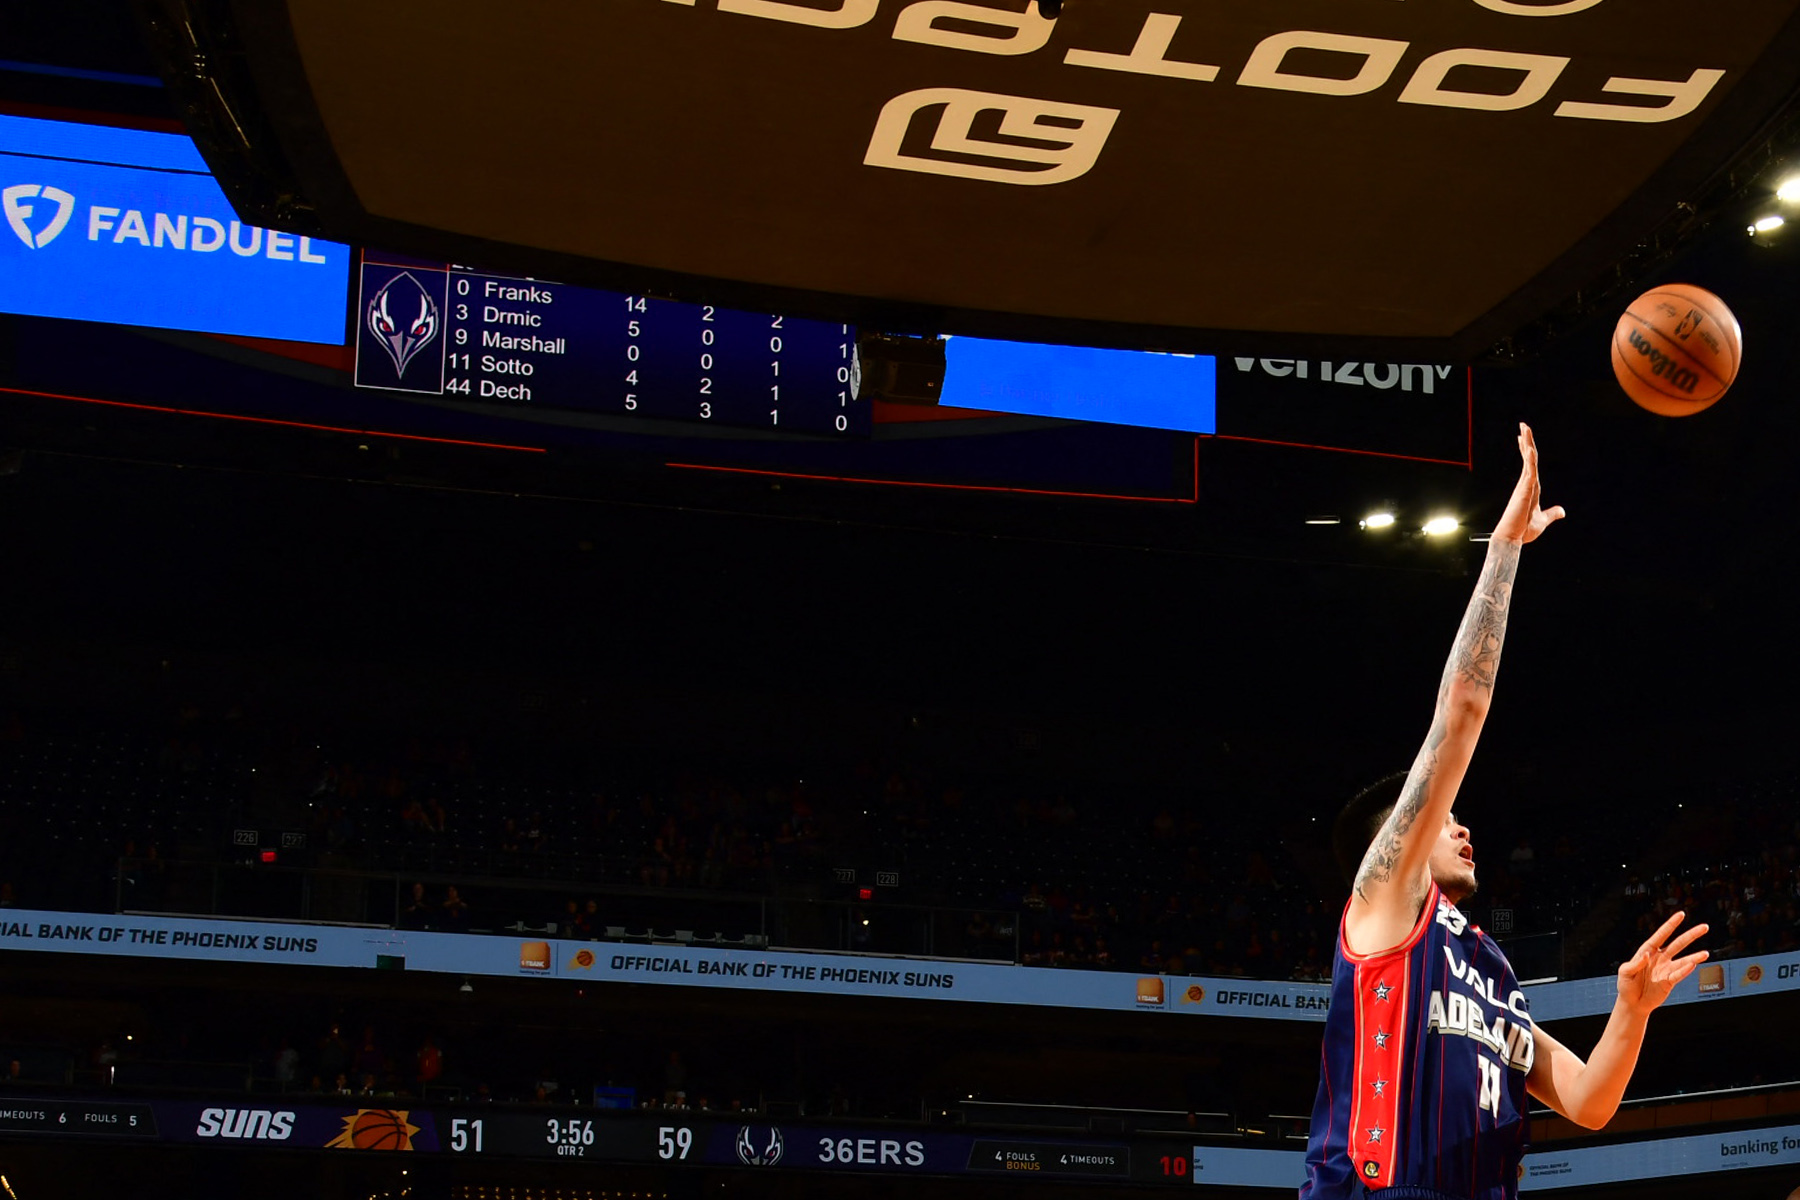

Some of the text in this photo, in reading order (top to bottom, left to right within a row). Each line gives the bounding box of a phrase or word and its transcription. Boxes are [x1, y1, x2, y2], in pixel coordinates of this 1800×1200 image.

[88, 205, 326, 264] FANDUEL
[457, 280, 715, 321] 0 Franks 14 2
[456, 305, 847, 358] 3 Drmic 5 0 0 1
[455, 329, 849, 383] 9 Marshall 0 0 1 0
[1629, 328, 1700, 394] Wilson
[449, 354, 846, 406] 11 Sotto 4 2 1 1
[446, 379, 847, 431] 44 Dech 5 3 1 0
[1436, 903, 1467, 936] 23
[38, 924, 94, 942] BANK
[100, 926, 125, 942] OF
[129, 928, 167, 945] THE
[172, 931, 259, 949] PHOENIX
[263, 936, 318, 953] SUNS
[610, 955, 954, 989] OFFICIAL BANK OF THE PHOENIX SUNS
[1216, 990, 1330, 1010] OFFICIAL BAN
[1427, 989, 1535, 1077] ADELAID
[1478, 1053, 1501, 1119] 11
[0, 1109, 138, 1126] IMEOUTS 6 FOULS 5
[196, 1107, 296, 1141] SUNS
[546, 1118, 595, 1146] 3:56
[451, 1118, 483, 1153] 51
[557, 1145, 585, 1157] QTR 2
[658, 1126, 693, 1160] 59
[818, 1137, 925, 1166] 36ERS
[1721, 1138, 1779, 1157] banking
[995, 1151, 1036, 1161] 4 FOULS
[1006, 1161, 1041, 1171] BONUS
[1060, 1154, 1115, 1165] 4 TIMEOUTS
[1160, 1156, 1187, 1177] 10
